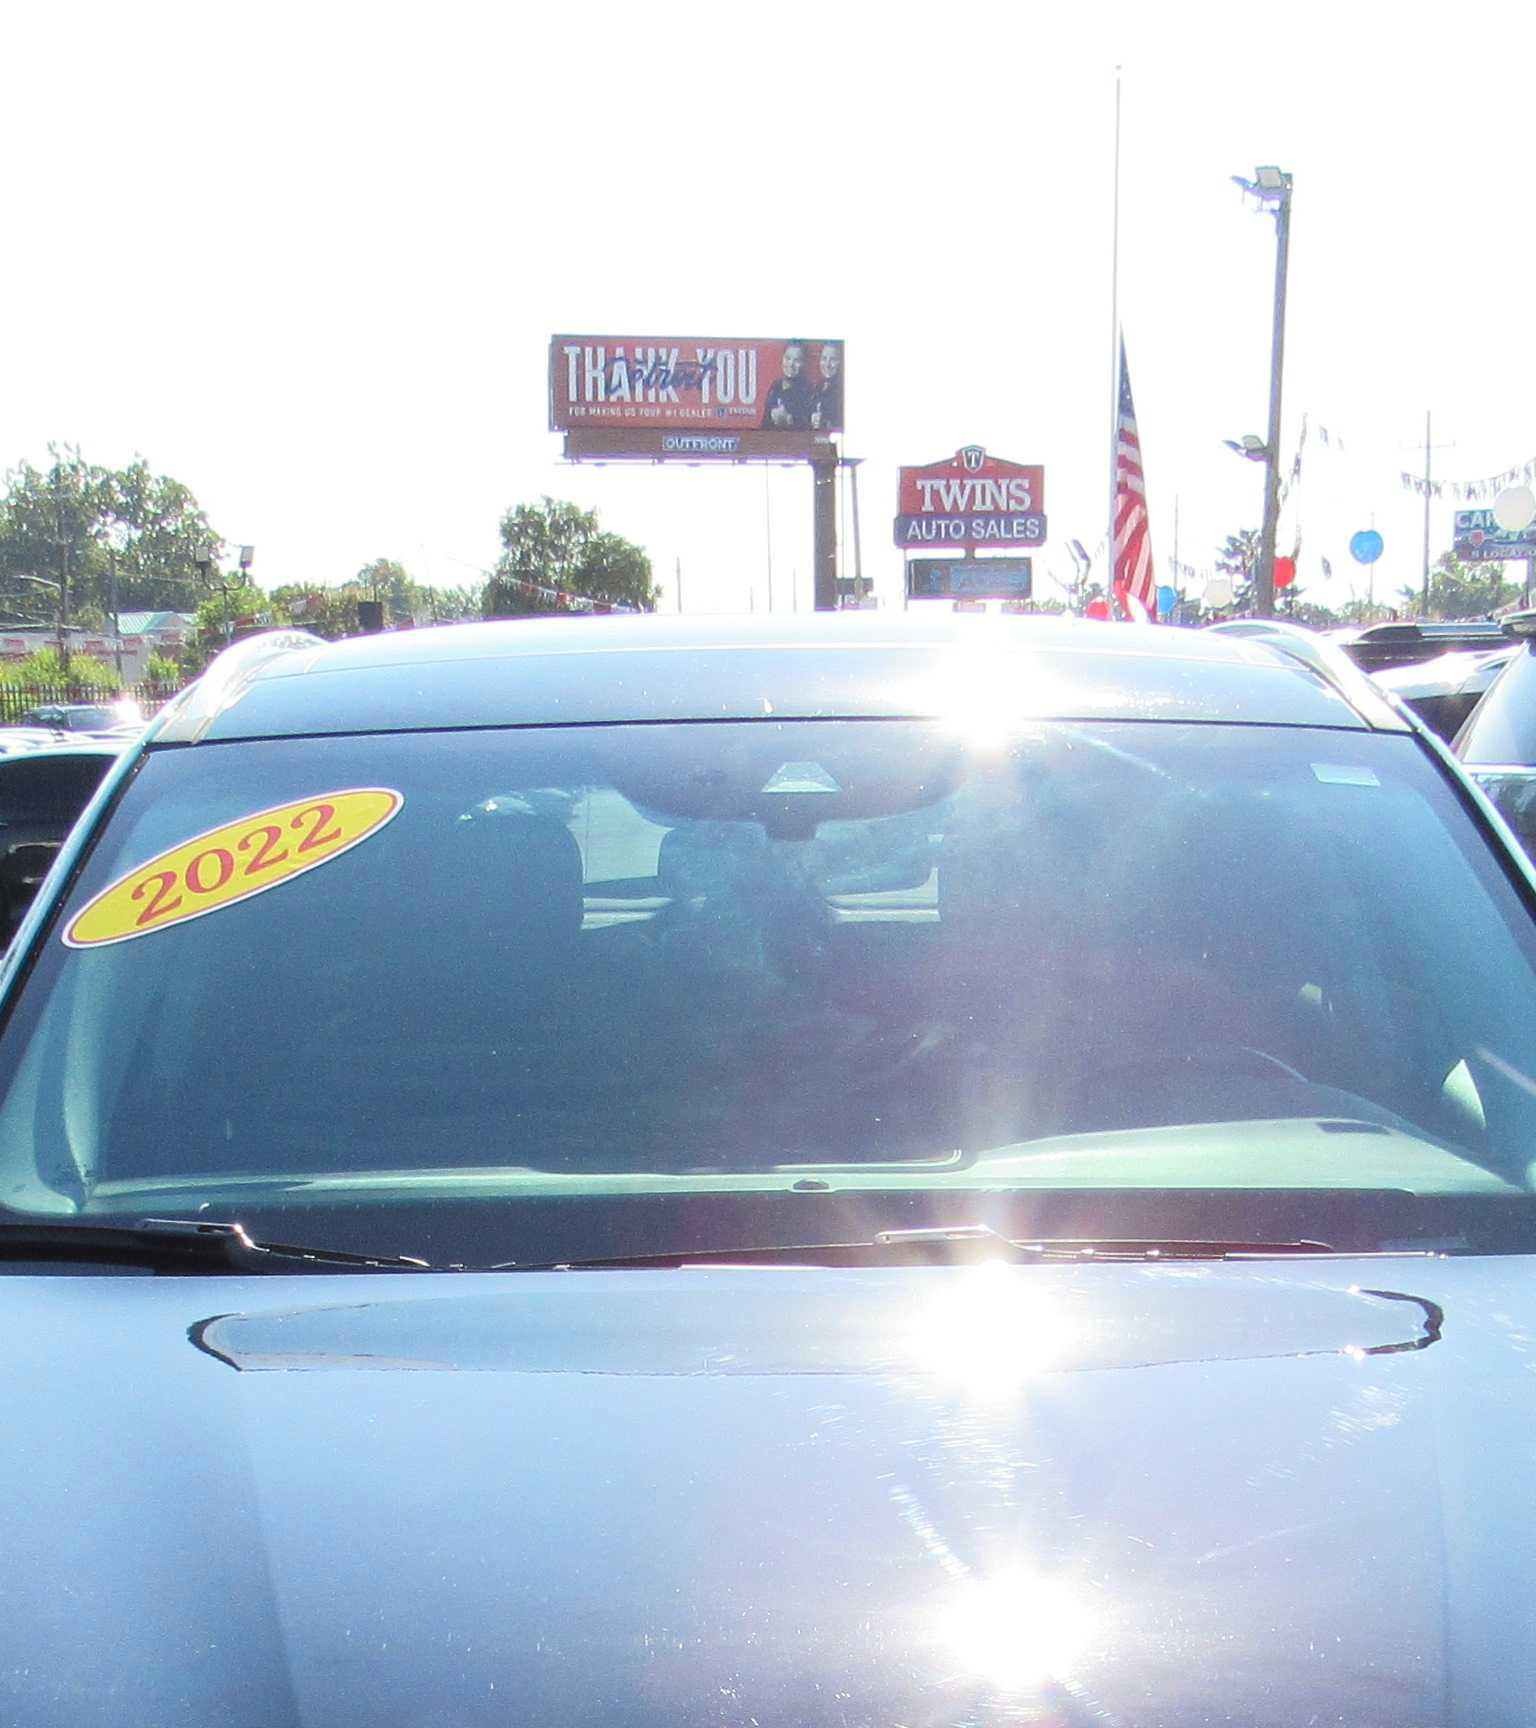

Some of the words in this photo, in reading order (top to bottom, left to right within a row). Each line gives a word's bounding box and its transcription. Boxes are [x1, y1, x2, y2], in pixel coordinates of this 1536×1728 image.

[563, 346, 680, 403] THANK
[696, 348, 757, 405] YOU
[568, 407, 585, 417] FOR
[665, 436, 736, 451] OUTFRONT
[916, 478, 1032, 513] TWINS
[906, 519, 965, 541] AUTO
[971, 518, 1040, 540] SALES
[131, 804, 342, 926] 2022
